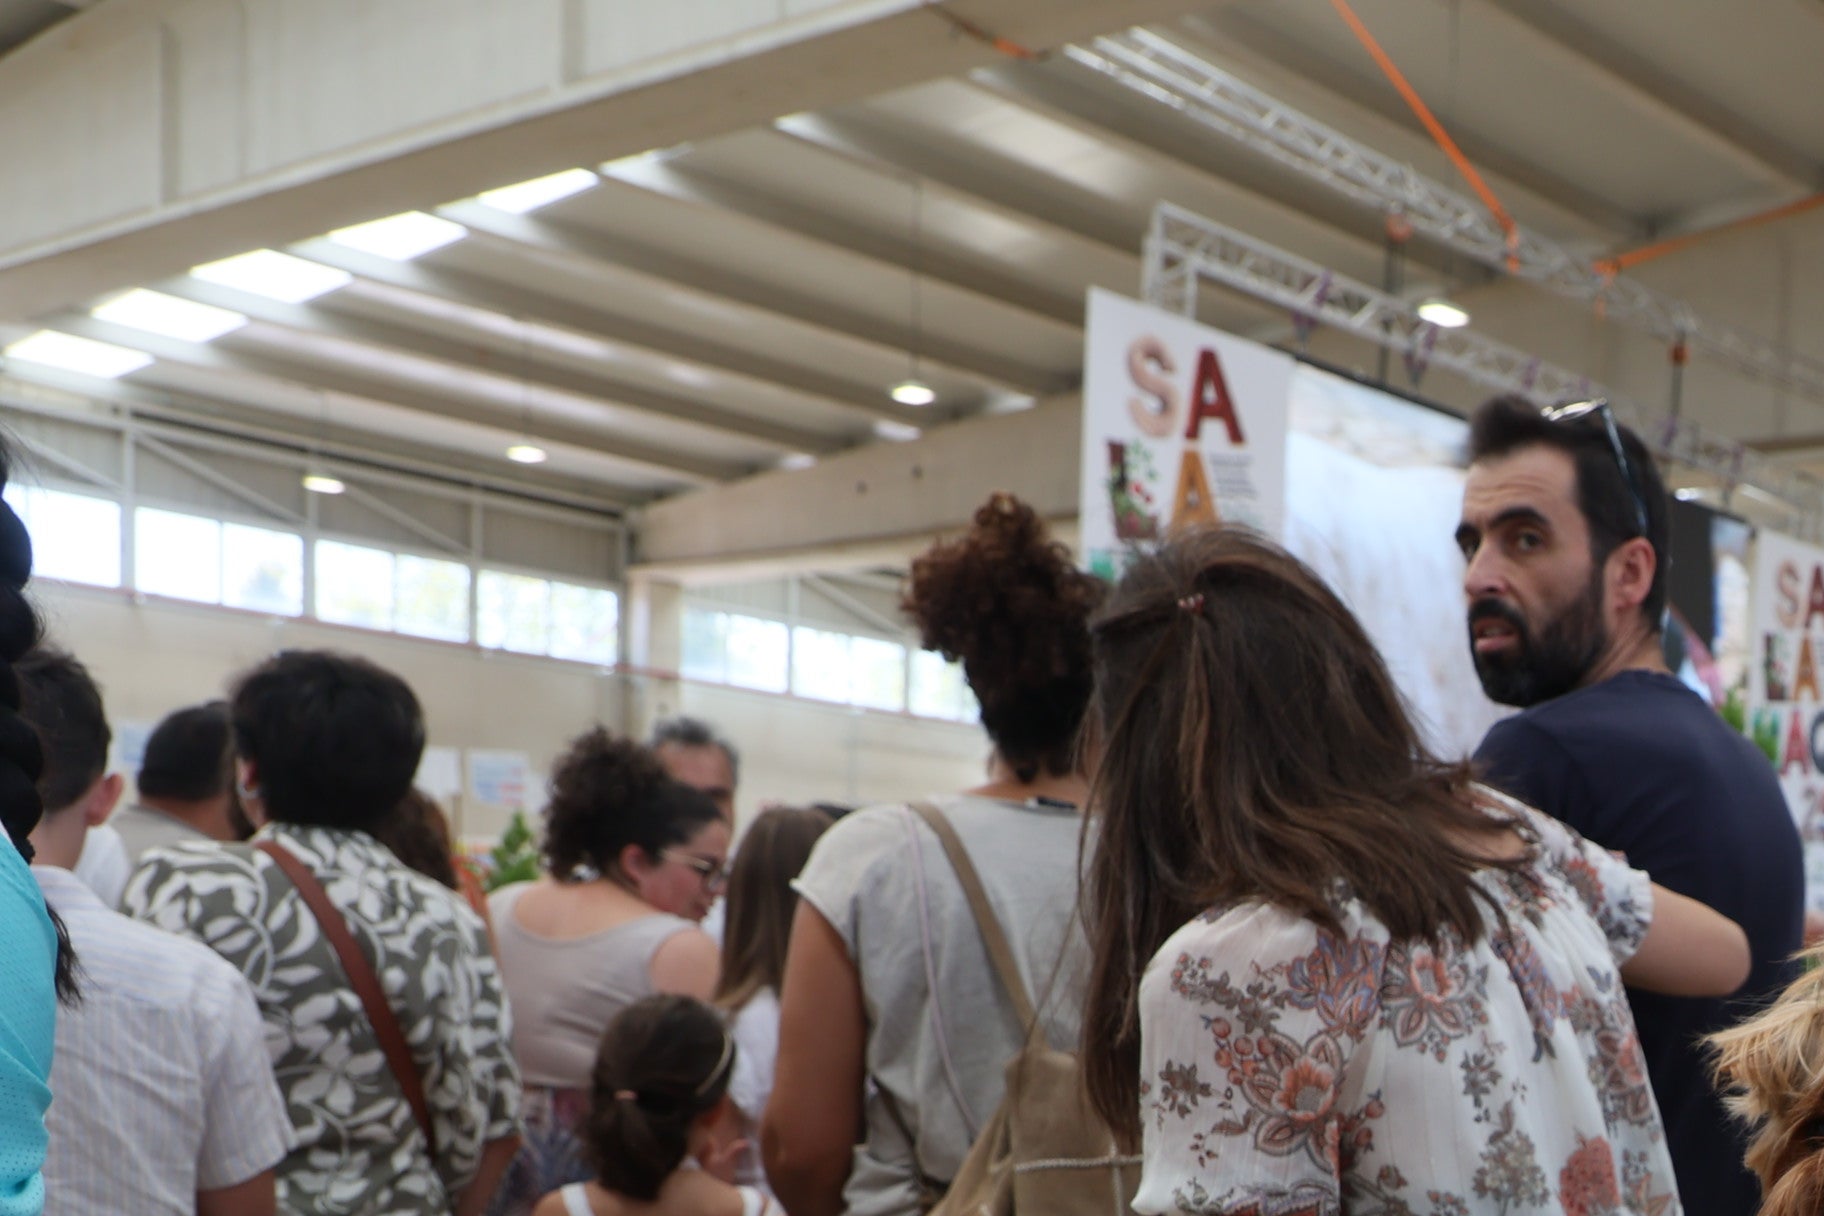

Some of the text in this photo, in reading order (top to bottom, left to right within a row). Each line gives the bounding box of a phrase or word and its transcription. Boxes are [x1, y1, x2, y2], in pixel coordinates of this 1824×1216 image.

[1128, 335, 1247, 445] SA
[1107, 440, 1223, 541] LA
[1764, 631, 1822, 703] LA
